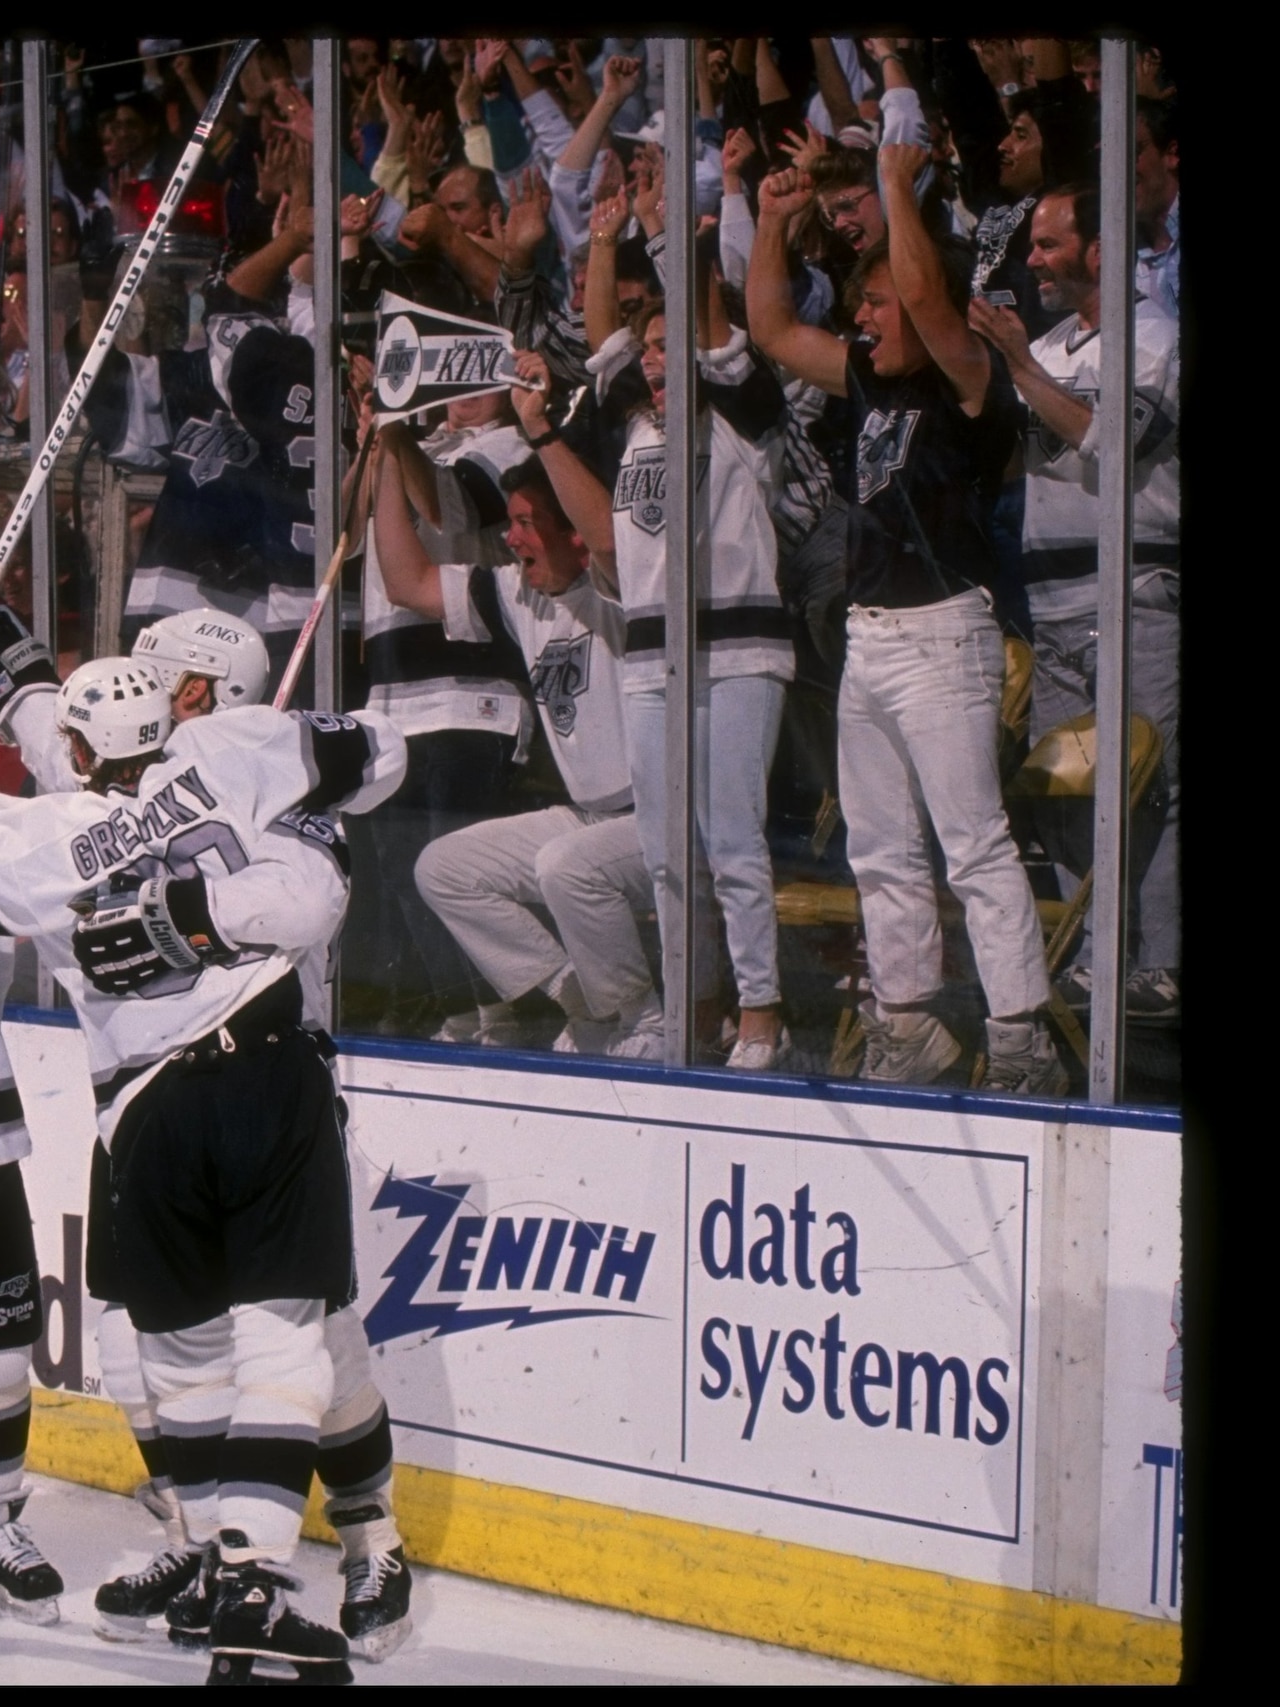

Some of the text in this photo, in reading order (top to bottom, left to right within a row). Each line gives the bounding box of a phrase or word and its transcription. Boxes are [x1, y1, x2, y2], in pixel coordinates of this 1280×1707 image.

[39, 425, 65, 471] 830
[195, 622, 245, 645] KINGS
[138, 721, 159, 745] 99
[699, 1163, 861, 1297] data
[358, 1163, 665, 1347] ZENITH
[83, 1376, 101, 1397] SM
[699, 1312, 1010, 1446] systems
